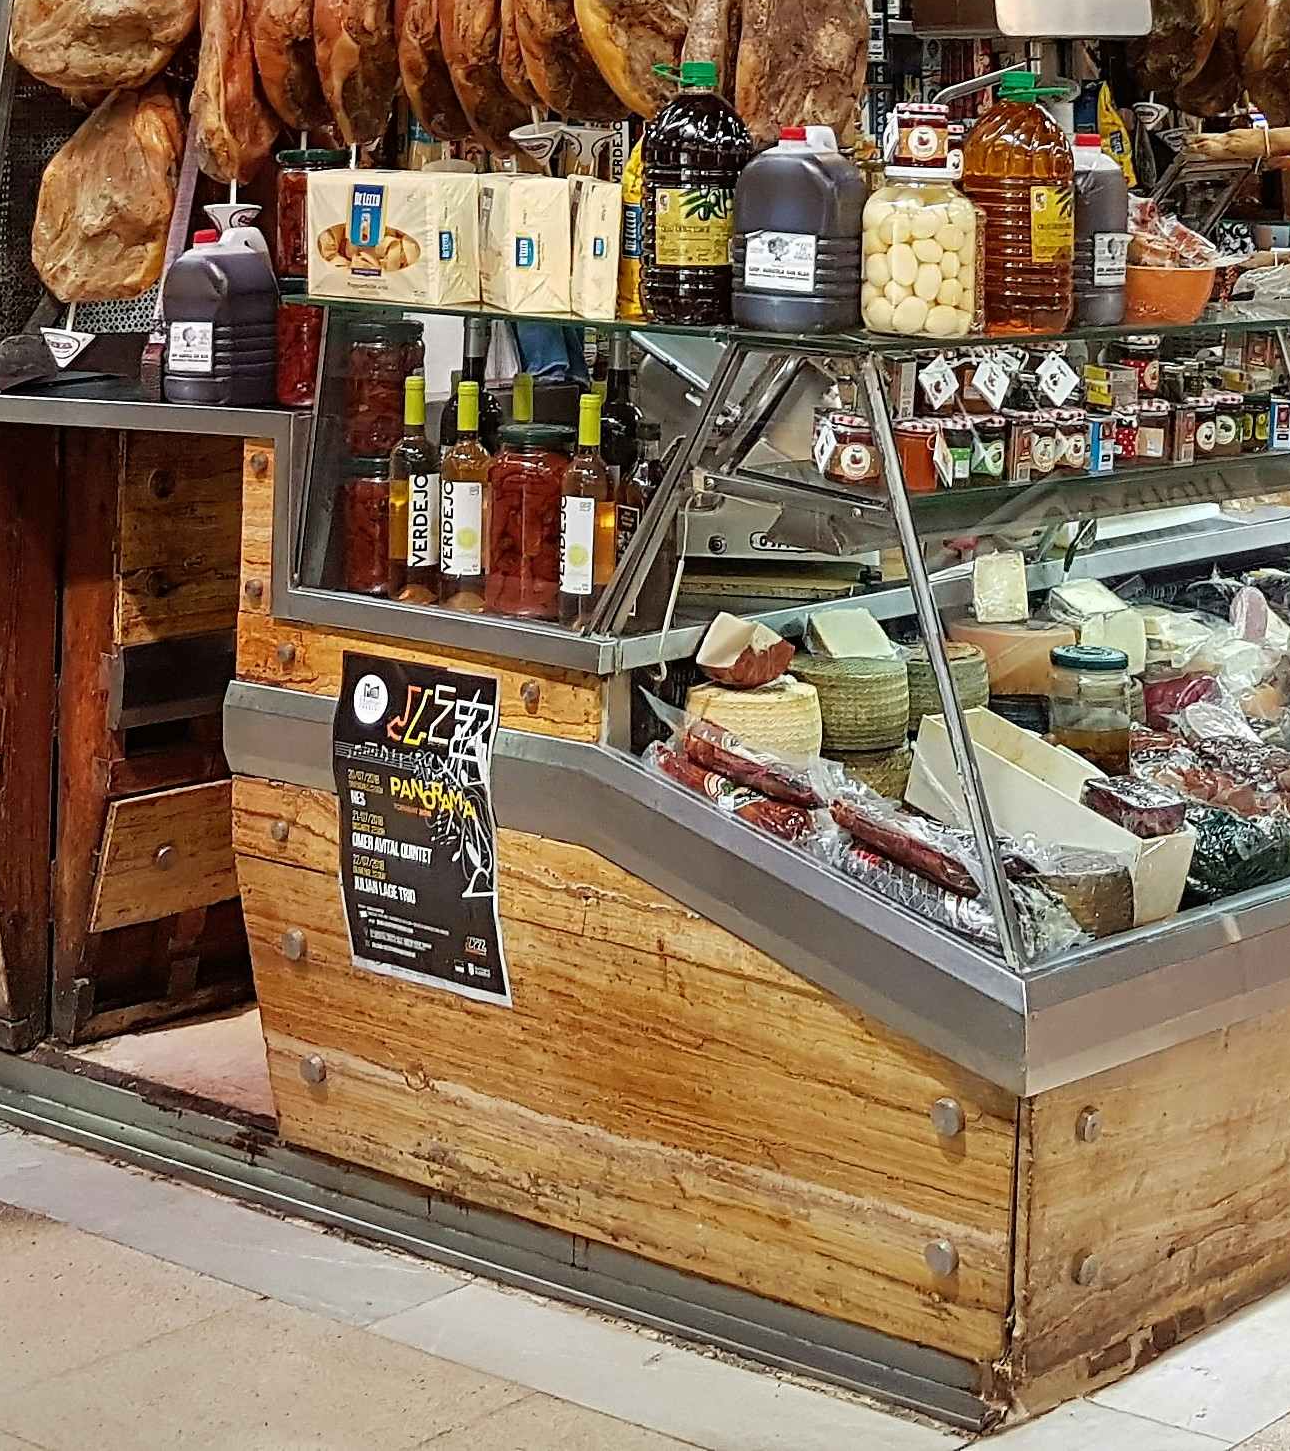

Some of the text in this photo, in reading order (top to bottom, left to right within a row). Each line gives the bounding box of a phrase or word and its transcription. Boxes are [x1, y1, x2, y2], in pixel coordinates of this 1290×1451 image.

[612, 120, 624, 184] VERDEJO
[412, 473, 429, 567] VERDEJO
[440, 480, 454, 572] VERDEJO
[389, 776, 477, 820] PANORAMA
